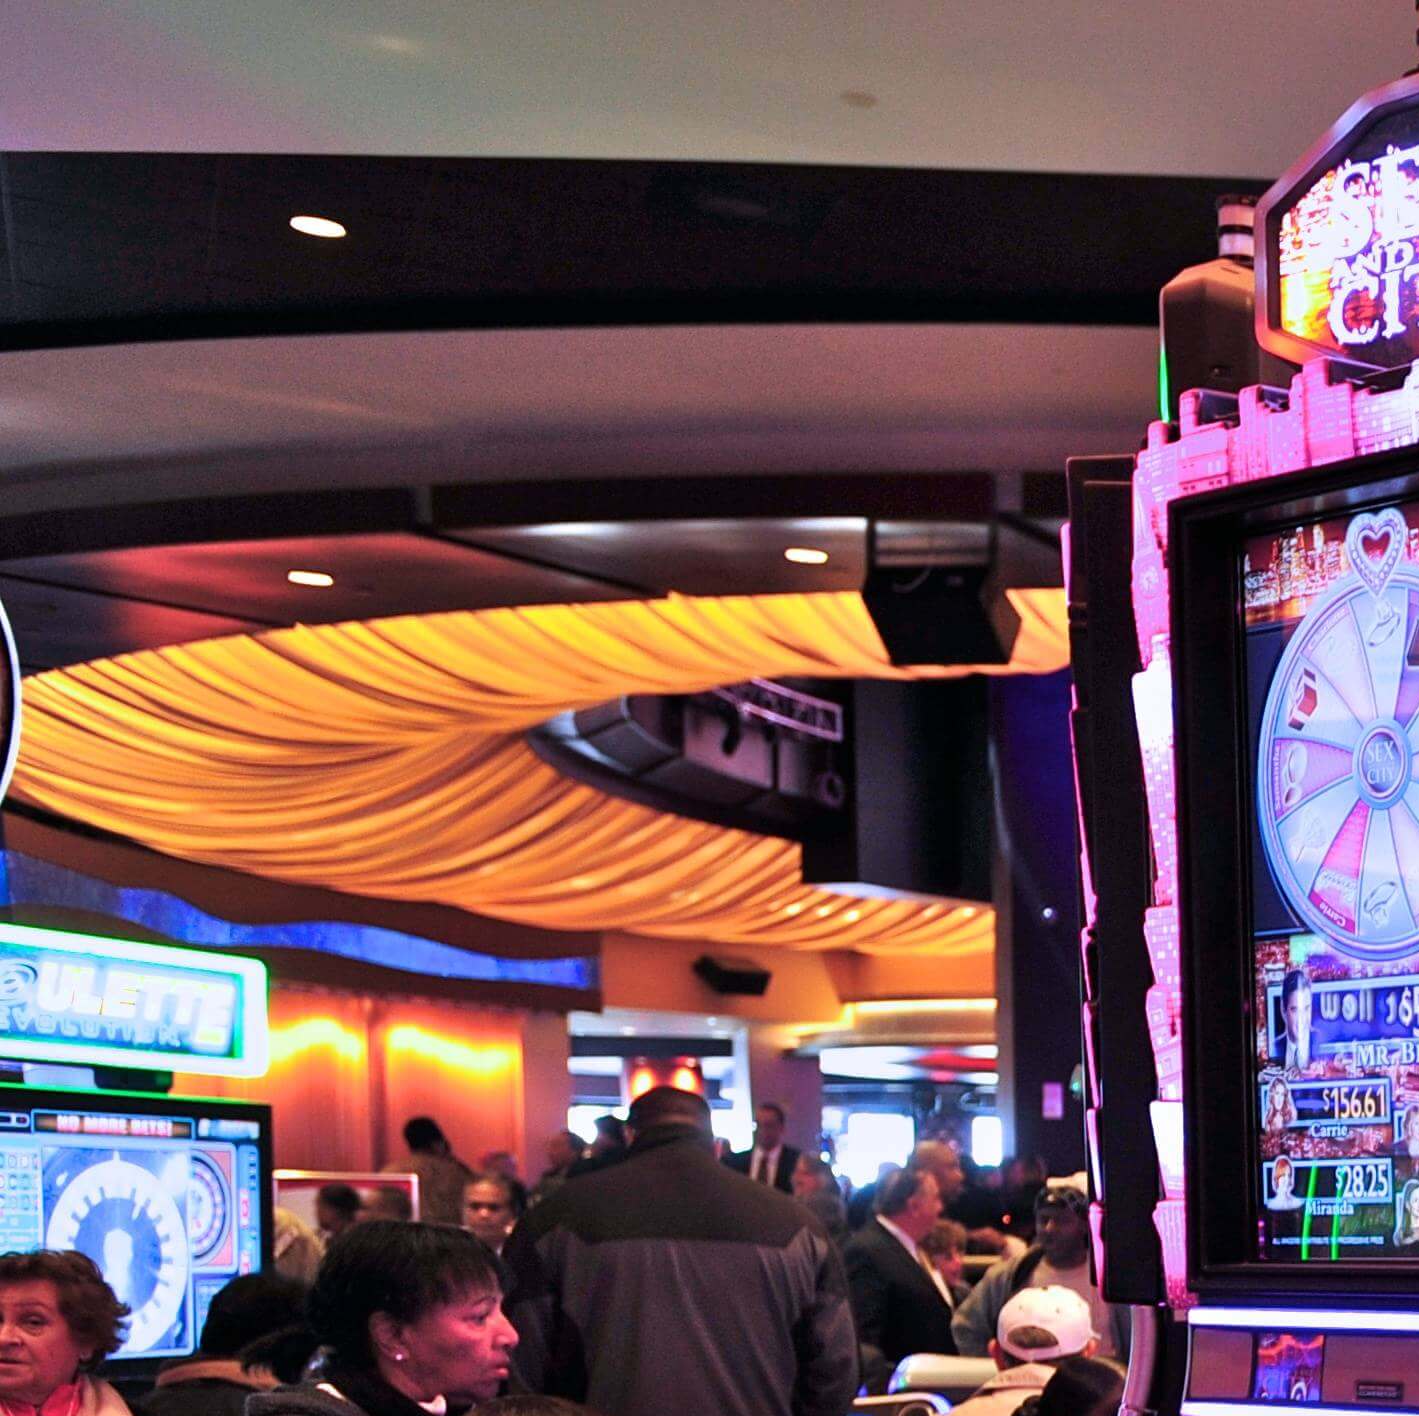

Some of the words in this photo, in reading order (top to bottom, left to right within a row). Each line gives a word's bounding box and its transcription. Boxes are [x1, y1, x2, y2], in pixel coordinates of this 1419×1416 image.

[1329, 241, 1414, 288] AND
[1356, 1043, 1396, 1067] MR.
[1322, 1085, 1386, 1119] $156.61
[56, 1115, 81, 1133] NO
[83, 1117, 129, 1135] MORE
[130, 1119, 174, 1137] BETS!
[1310, 1123, 1348, 1138] Carrie
[1335, 1164, 1389, 1199] $28.25
[1305, 1200, 1355, 1216] Miranda
